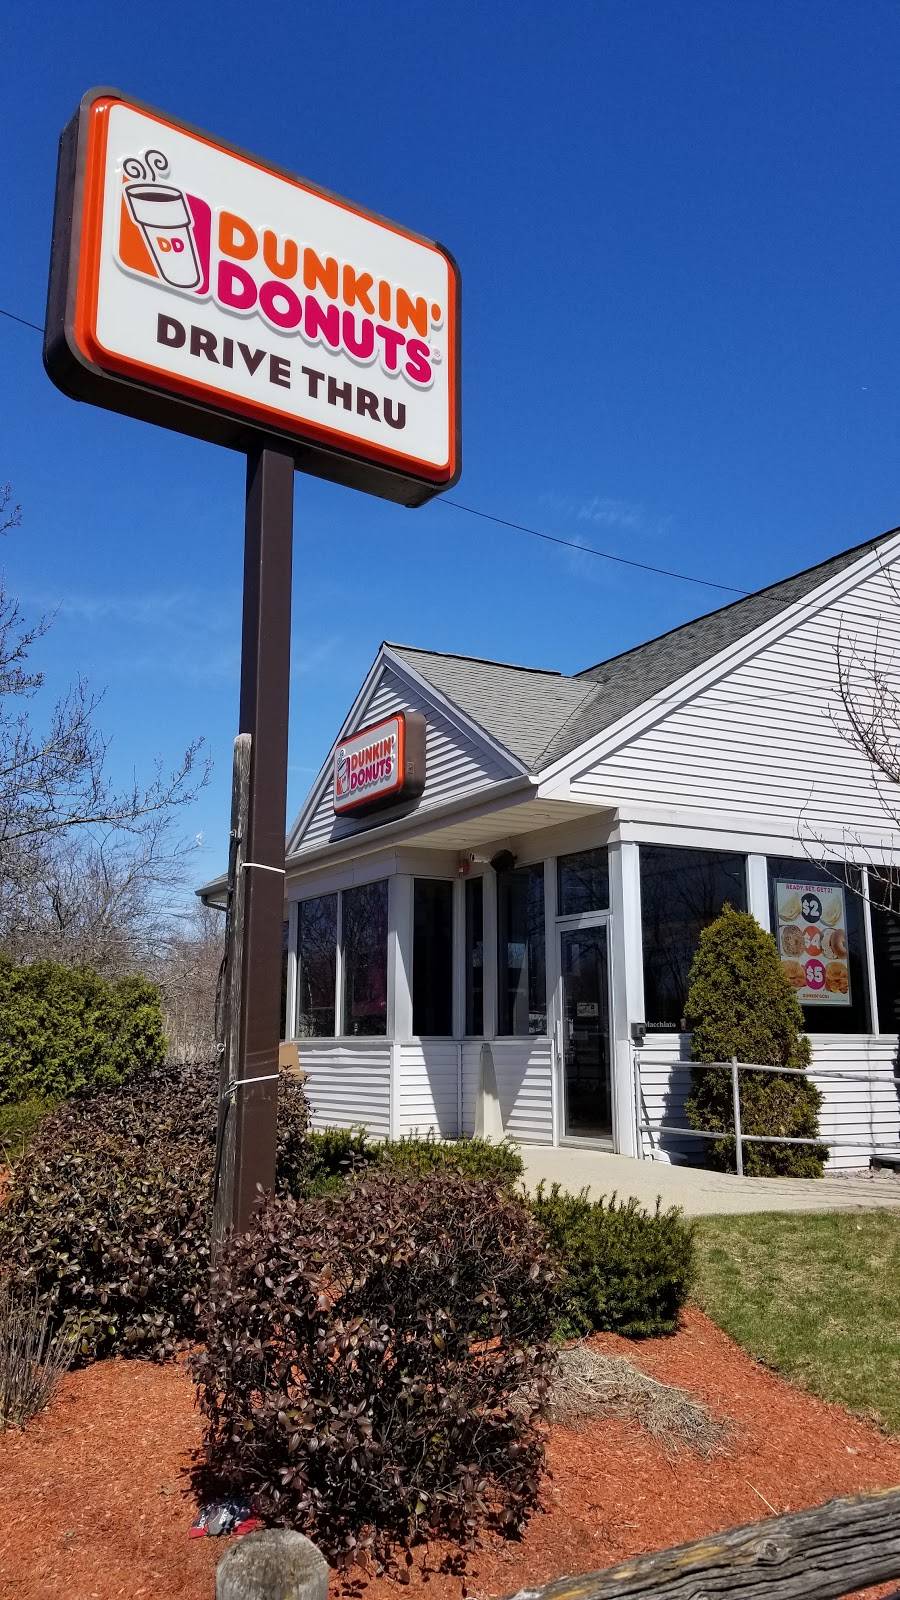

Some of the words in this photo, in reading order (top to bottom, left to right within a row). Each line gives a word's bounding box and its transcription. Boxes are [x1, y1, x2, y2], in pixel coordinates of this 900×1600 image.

[218, 210, 441, 338] DUNKIN'
[217, 259, 432, 383] DONUTS
[156, 312, 291, 389] DRIVE
[301, 365, 406, 430] THRU
[351, 735, 395, 771] DUNKIN'
[351, 756, 392, 789] DONUTS
[802, 899, 820, 917] $2
[806, 965, 824, 983] $5
